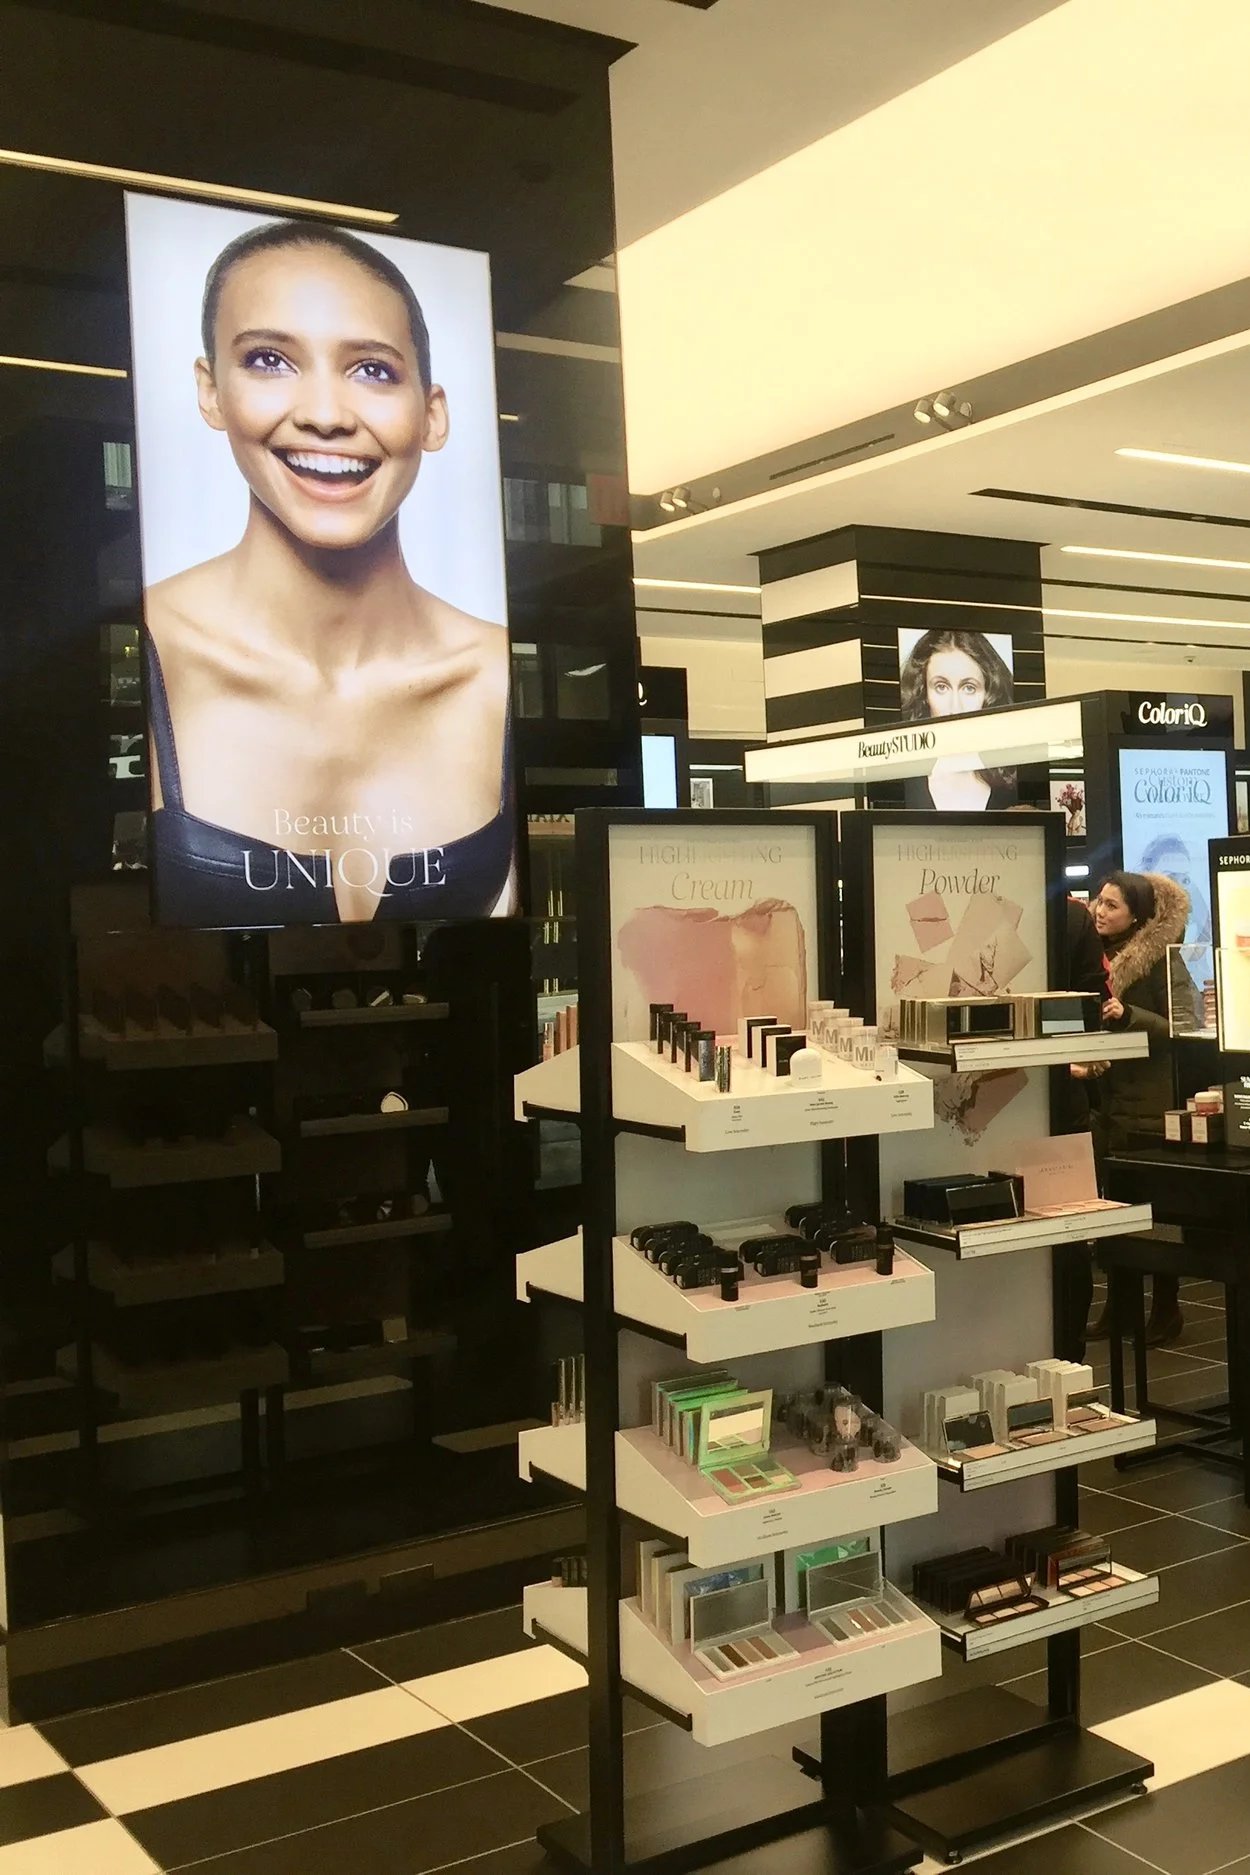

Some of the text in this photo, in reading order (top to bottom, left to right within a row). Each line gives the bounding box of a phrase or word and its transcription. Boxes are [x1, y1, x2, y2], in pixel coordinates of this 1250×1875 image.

[274, 808, 414, 841] Beauty is
[241, 847, 446, 897] UNIQUE
[671, 871, 753, 900] Cream
[920, 868, 1000, 895] Powder
